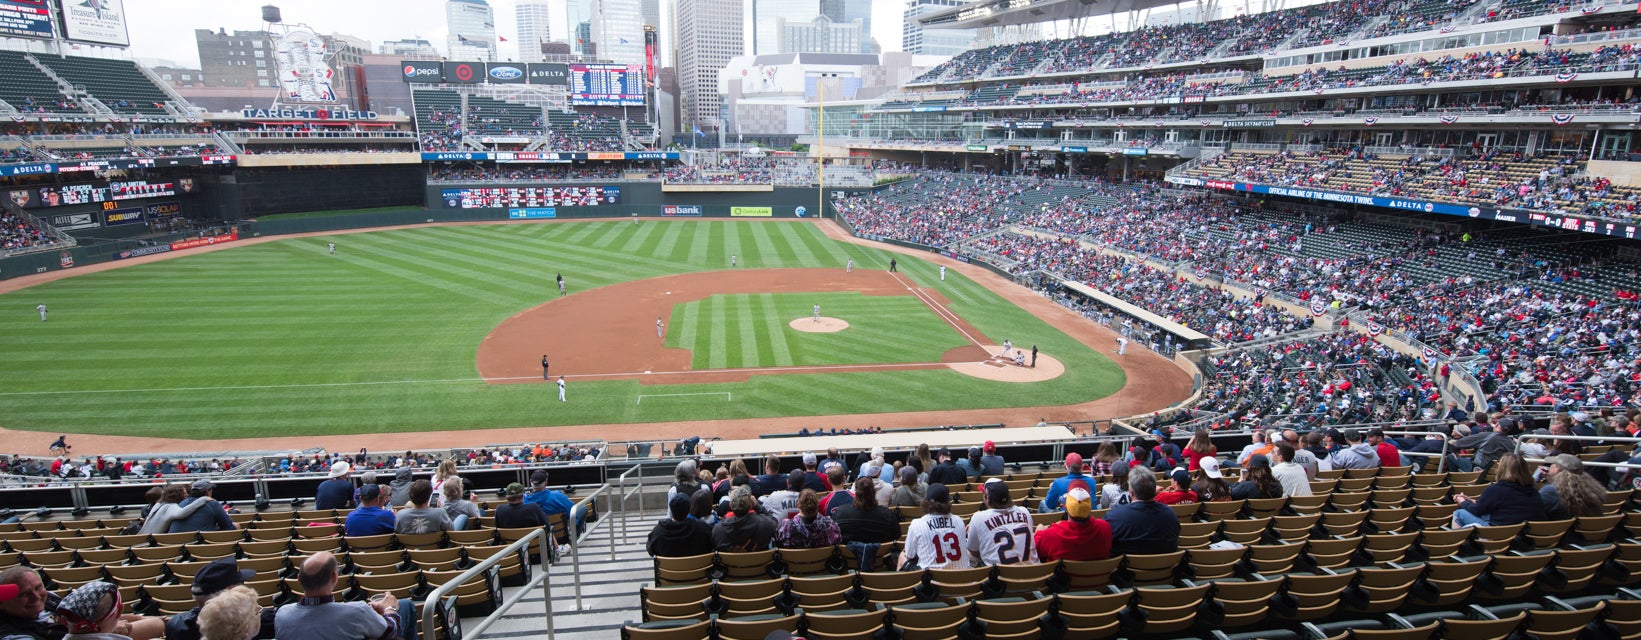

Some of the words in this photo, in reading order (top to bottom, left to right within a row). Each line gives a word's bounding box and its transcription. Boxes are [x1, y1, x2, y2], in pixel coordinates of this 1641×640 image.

[69, 6, 96, 18] Treasure
[101, 10, 119, 21] Island
[416, 67, 439, 77] pepsi
[496, 69, 515, 77] Ford
[243, 109, 315, 119] TARGET
[332, 110, 378, 119] FIELD
[20, 165, 43, 173] DELTA
[1268, 187, 1288, 195] OFFICIAL
[1288, 189, 1306, 197] AIRLINE
[1306, 190, 1312, 198] OF
[1313, 191, 1323, 199] THE
[1323, 193, 1354, 203] MINNESOTA
[1397, 201, 1421, 209] DELTA
[108, 211, 141, 222] SUBWAY
[1495, 214, 1517, 222] MAUER
[1545, 217, 1561, 227] 0-0
[1293, 456, 1310, 464] AUER
[781, 499, 798, 510] MAU
[927, 517, 956, 530] KUBEL
[984, 512, 1029, 531] KINTZLER
[932, 532, 962, 563] 13
[993, 526, 1030, 564] 27
